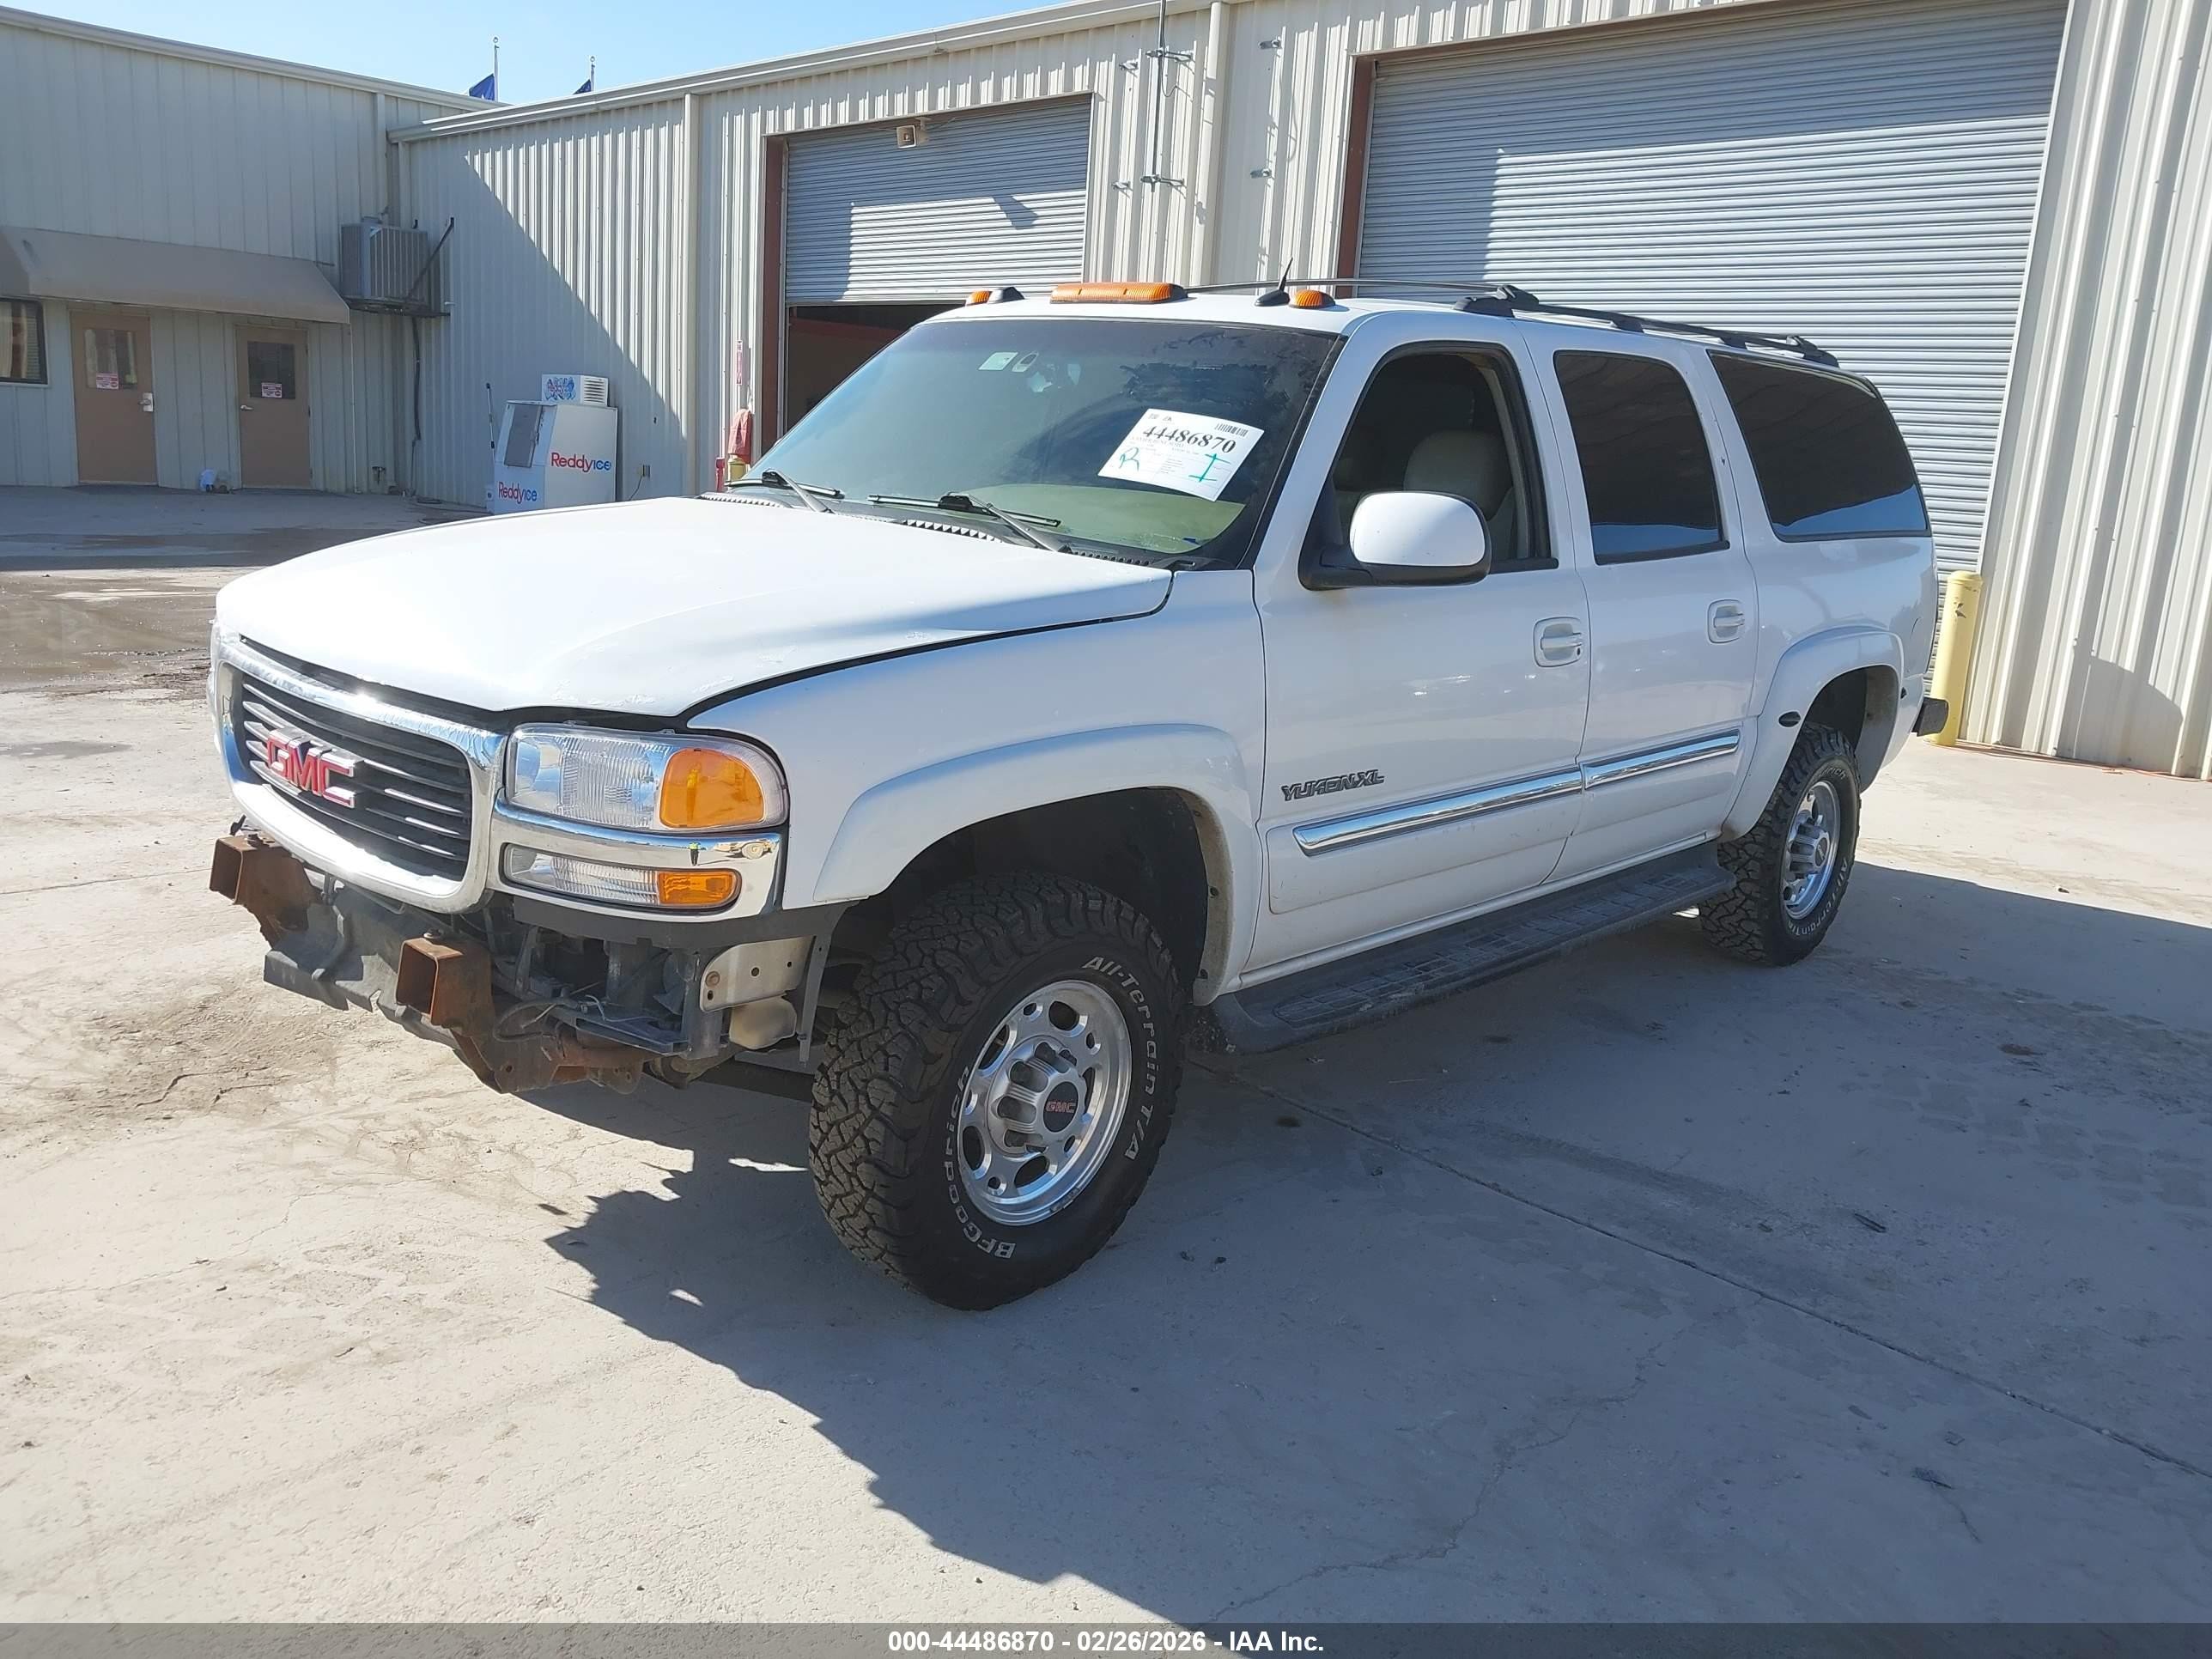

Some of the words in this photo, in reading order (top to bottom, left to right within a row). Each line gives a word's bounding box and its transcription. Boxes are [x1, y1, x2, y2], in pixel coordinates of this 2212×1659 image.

[1142, 425, 1237, 453] 44486870
[266, 729, 356, 809] GMC
[1082, 956, 1160, 1096] All-Terrain
[1124, 1104, 1154, 1160] T/A
[1045, 1101, 1077, 1114] GMC
